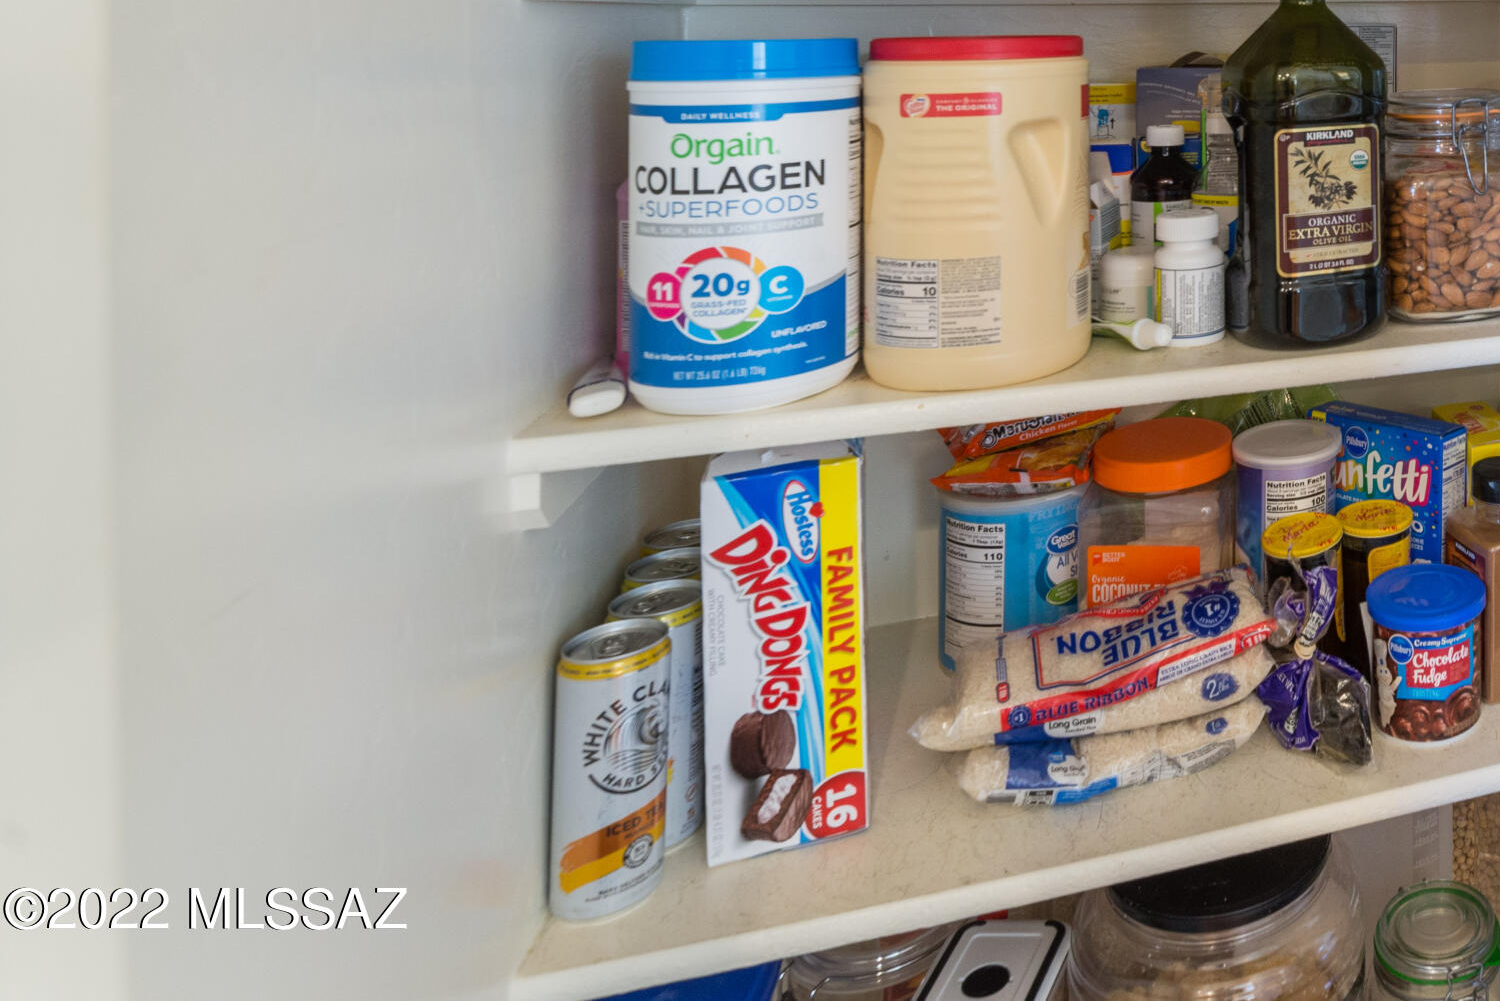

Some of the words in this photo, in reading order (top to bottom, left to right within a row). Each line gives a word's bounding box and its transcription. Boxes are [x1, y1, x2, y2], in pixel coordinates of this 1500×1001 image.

[681, 112, 707, 120] DAILY
[709, 111, 760, 120] WELLNESS
[955, 103, 997, 111] ORIGINAL
[1306, 129, 1354, 141] KIRKLAND
[670, 132, 775, 165] Orgain
[635, 158, 825, 195] COLLAGEN
[639, 192, 819, 218] +SUPERFOODS
[1308, 214, 1356, 227] ORGANIC
[1288, 226, 1332, 240] EXTRA
[1333, 222, 1373, 235] VIRGIN
[1312, 237, 1337, 246] OLIVE
[652, 282, 673, 301] 11
[691, 272, 750, 298] 20g
[769, 275, 788, 294] C
[922, 287, 936, 296] 10
[690, 299, 746, 309] GRASS-FED
[771, 320, 827, 338] UNFLAVORED
[704, 350, 736, 362] support
[1019, 425, 1056, 442] Chicken
[1057, 420, 1078, 430] Flavor
[1346, 434, 1369, 450] Pillsbury
[1267, 480, 1305, 489] Nutrition
[1307, 474, 1326, 484] Facts
[1336, 450, 1429, 503] unfetti
[1311, 495, 1326, 506] 100
[785, 490, 815, 557] Hostess
[946, 519, 976, 532] Nutrition
[978, 525, 1004, 533] Facts
[1051, 530, 1076, 546] Great
[984, 553, 1003, 561] 110
[1057, 556, 1070, 569] All
[1091, 574, 1126, 584] Organic
[827, 546, 857, 655] FAMILY
[1103, 618, 1179, 666] BLUE
[1390, 642, 1412, 657] Pillsbury
[1413, 639, 1441, 647] Creamy
[755, 605, 808, 711] DONGS
[1412, 645, 1469, 668] Chocolate
[1413, 667, 1448, 687] Fudge
[829, 665, 858, 754] PACK
[1036, 700, 1079, 721] BLUE
[1048, 718, 1070, 731] Long
[1071, 715, 1097, 727] Grain
[582, 700, 626, 768] WHITE
[602, 773, 646, 789] HARD
[811, 795, 823, 830] CAKES
[825, 783, 858, 829] 16
[606, 816, 642, 837] ICED
